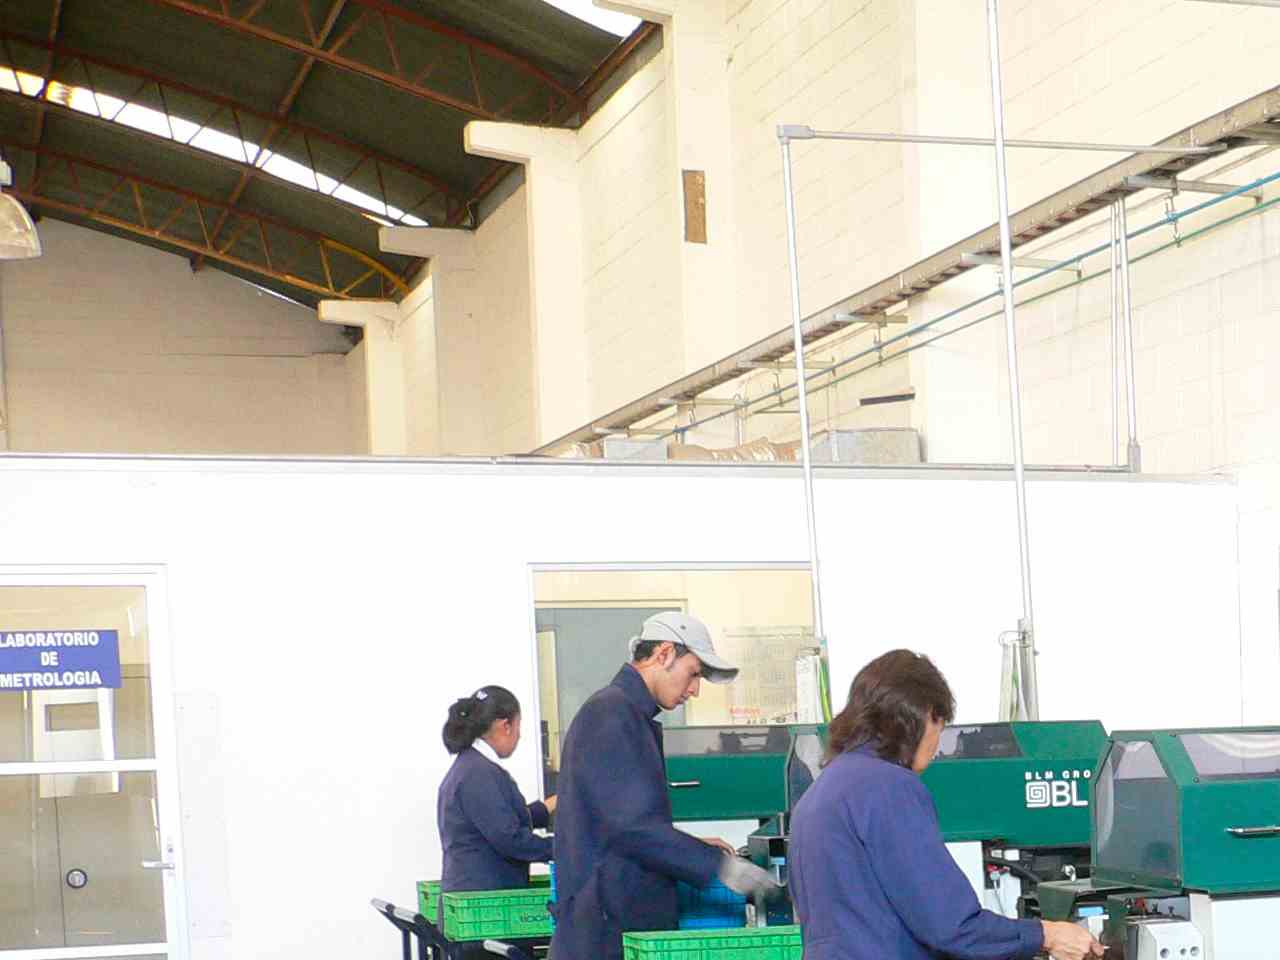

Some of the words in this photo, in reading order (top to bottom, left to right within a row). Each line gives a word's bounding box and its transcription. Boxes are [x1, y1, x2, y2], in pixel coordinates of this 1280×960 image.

[0, 632, 99, 648] LABORATORIO
[41, 651, 59, 666] DE
[0, 671, 102, 687] METROLOGIA
[1025, 771, 1054, 780] BLM
